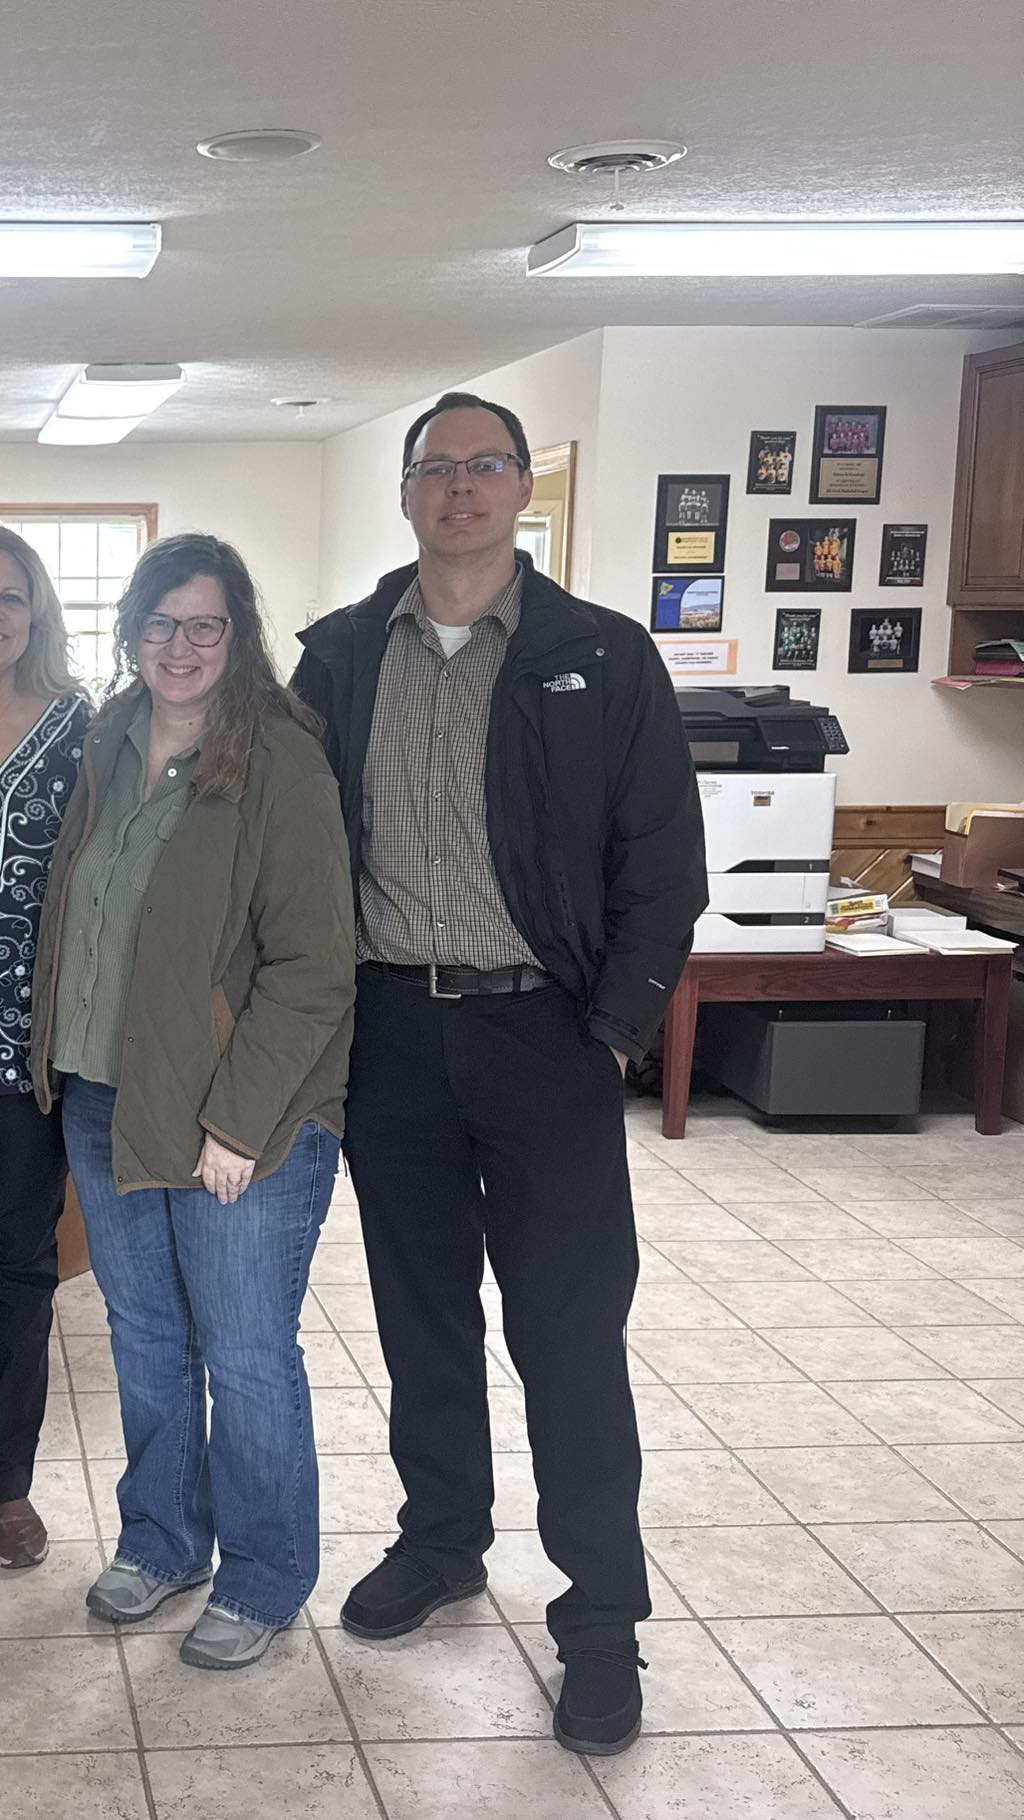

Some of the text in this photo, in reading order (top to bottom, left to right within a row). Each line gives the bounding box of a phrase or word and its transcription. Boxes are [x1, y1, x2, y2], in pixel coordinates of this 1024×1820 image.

[554, 673, 570, 681] THE
[543, 679, 571, 689] NORTH
[551, 684, 571, 692] FACE
